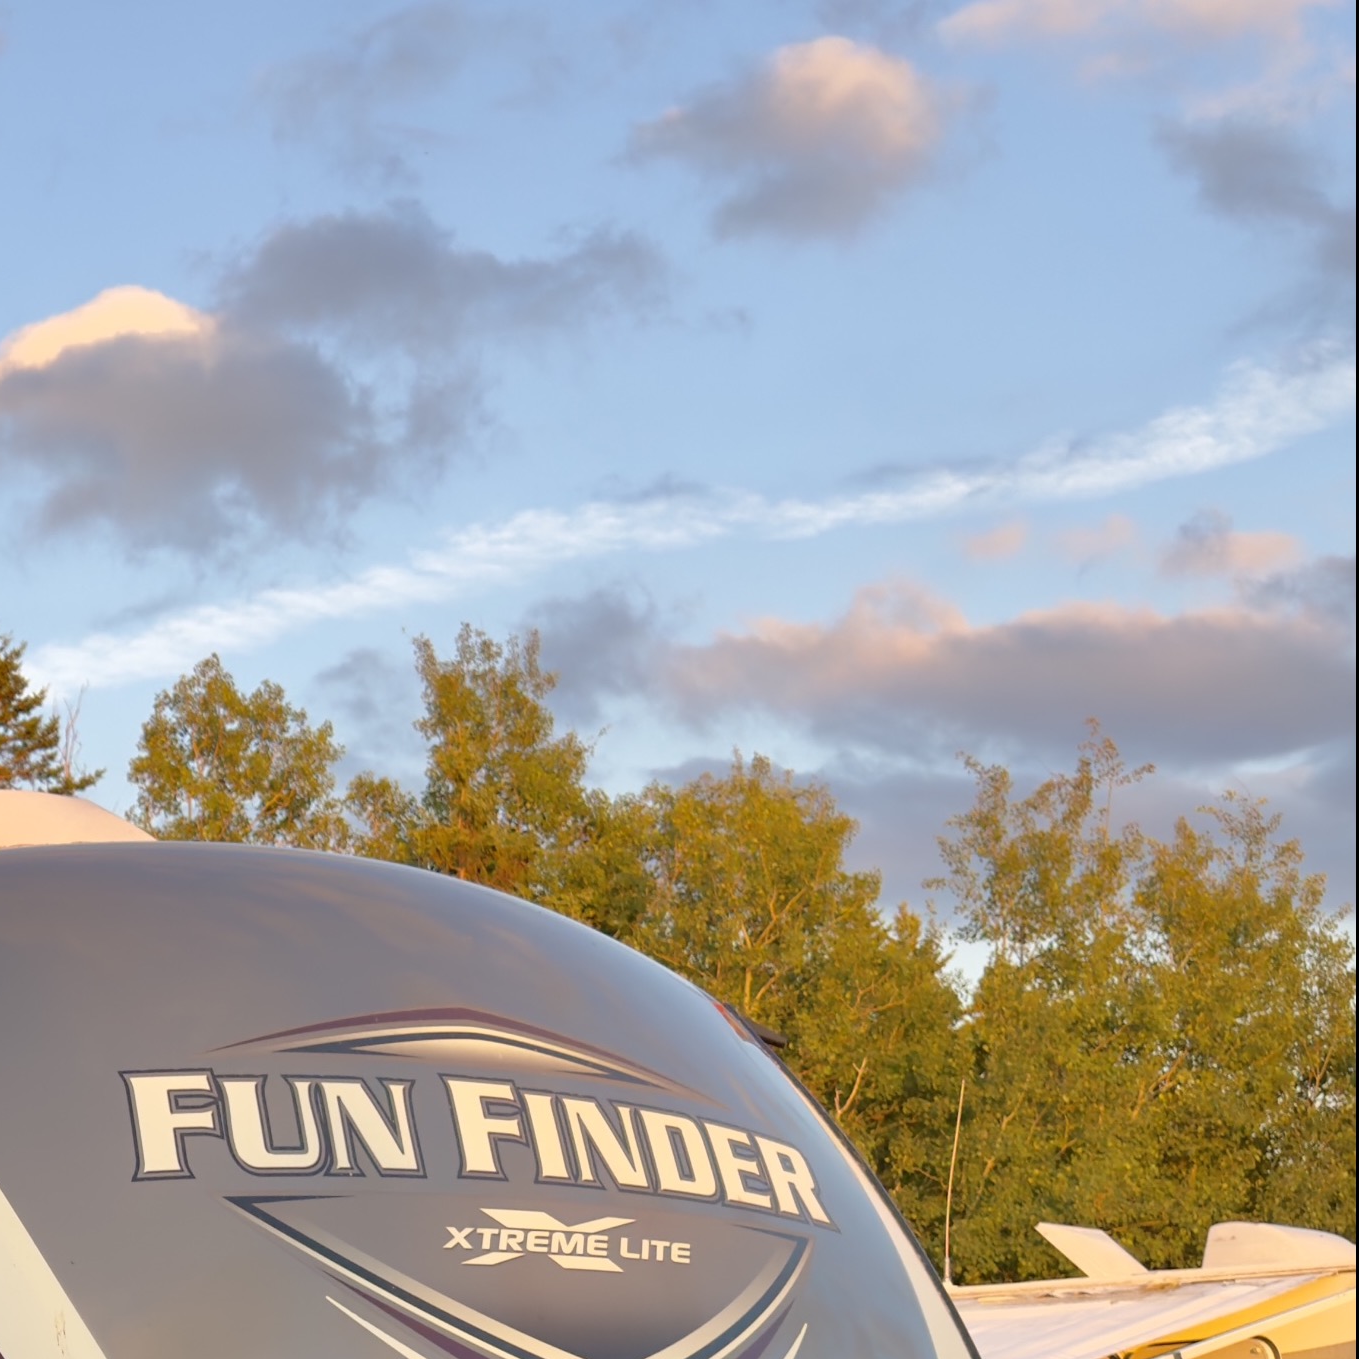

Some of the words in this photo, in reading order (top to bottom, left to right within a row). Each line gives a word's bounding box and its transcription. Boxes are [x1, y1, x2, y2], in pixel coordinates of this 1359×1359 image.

[118, 1067, 427, 1182] FUN
[439, 1073, 841, 1233] FINDER
[442, 1225, 609, 1257] XTREME
[619, 1236, 691, 1265] LITE
